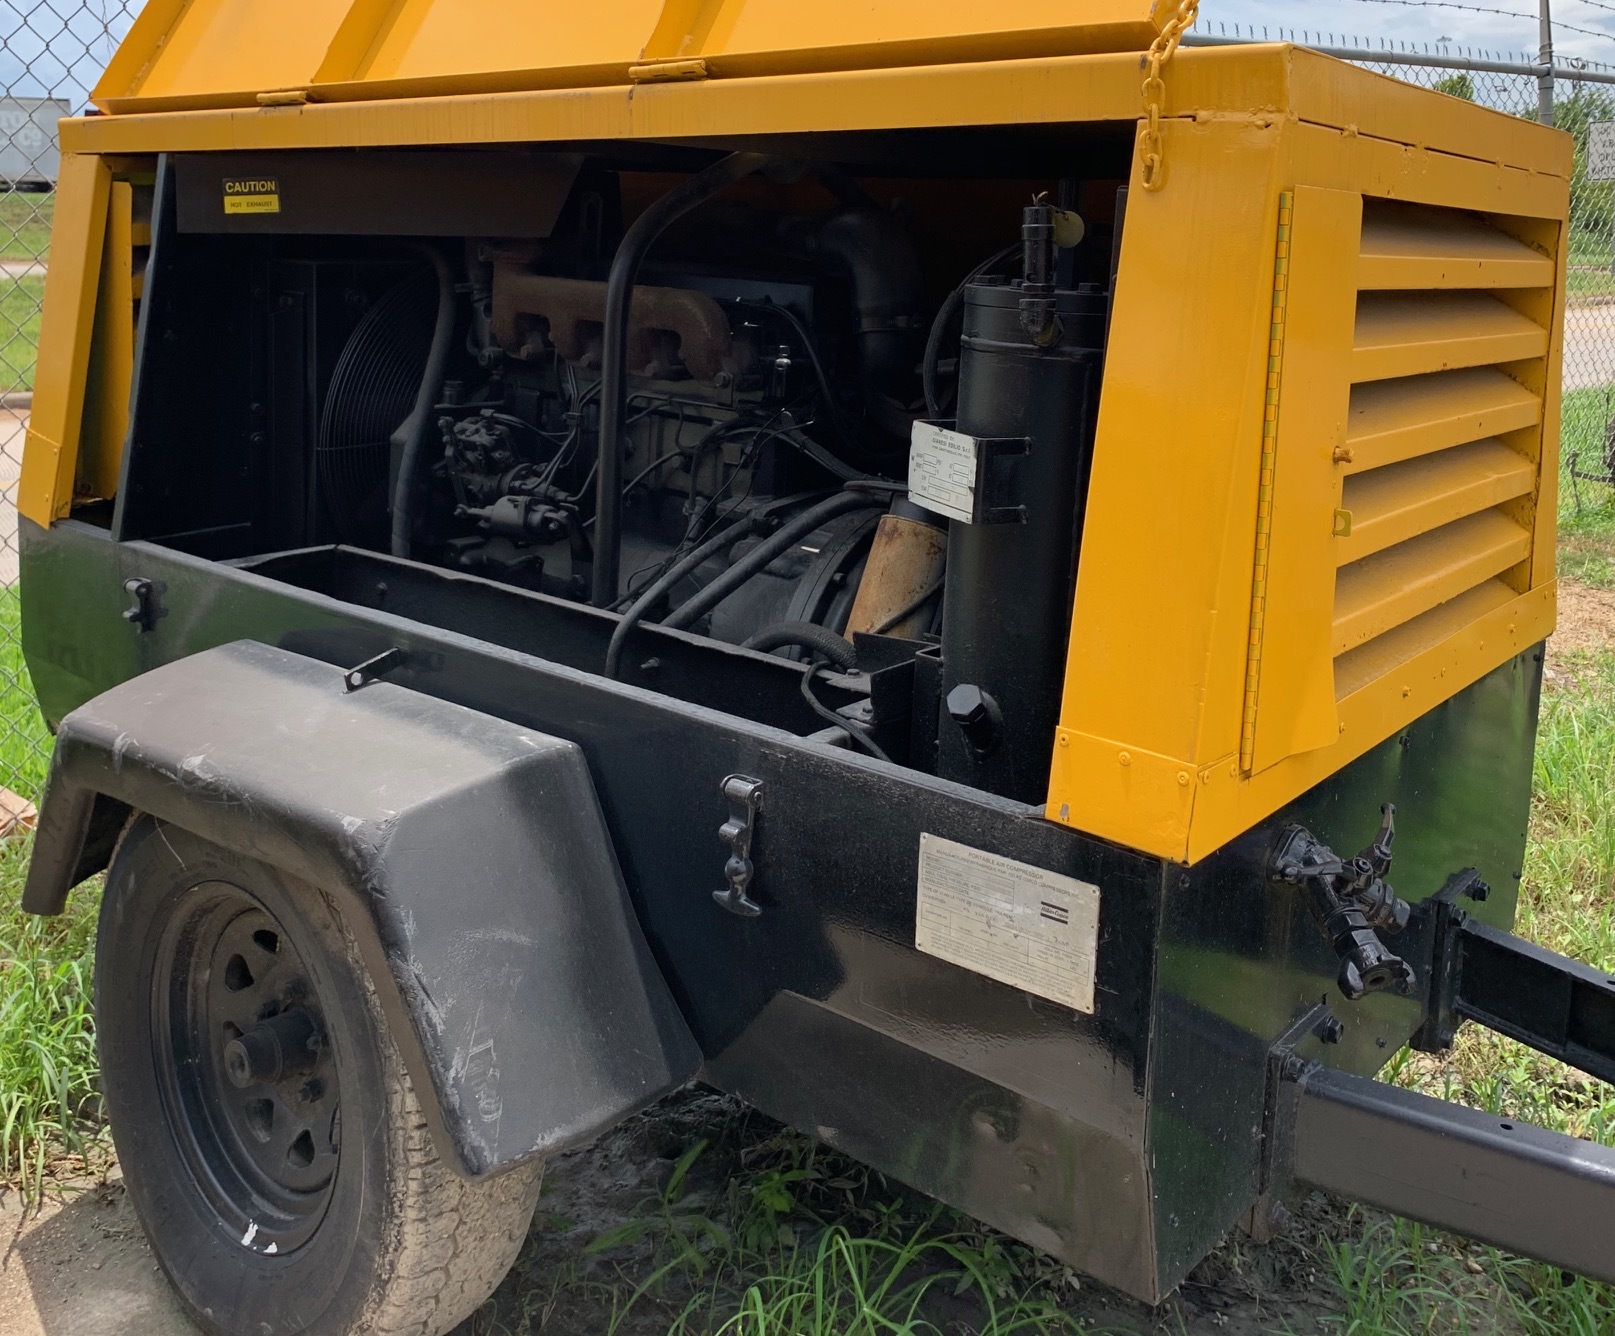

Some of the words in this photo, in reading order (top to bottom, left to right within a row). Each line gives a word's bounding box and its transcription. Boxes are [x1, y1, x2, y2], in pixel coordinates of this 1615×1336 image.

[225, 181, 276, 193] CAUTION
[246, 200, 273, 208] EXHAUST
[969, 852, 994, 864] PORTABLE
[1006, 864, 1043, 880] COMPRESSOR
[1041, 906, 1054, 915] Atlas
[1054, 910, 1069, 920] Copco
